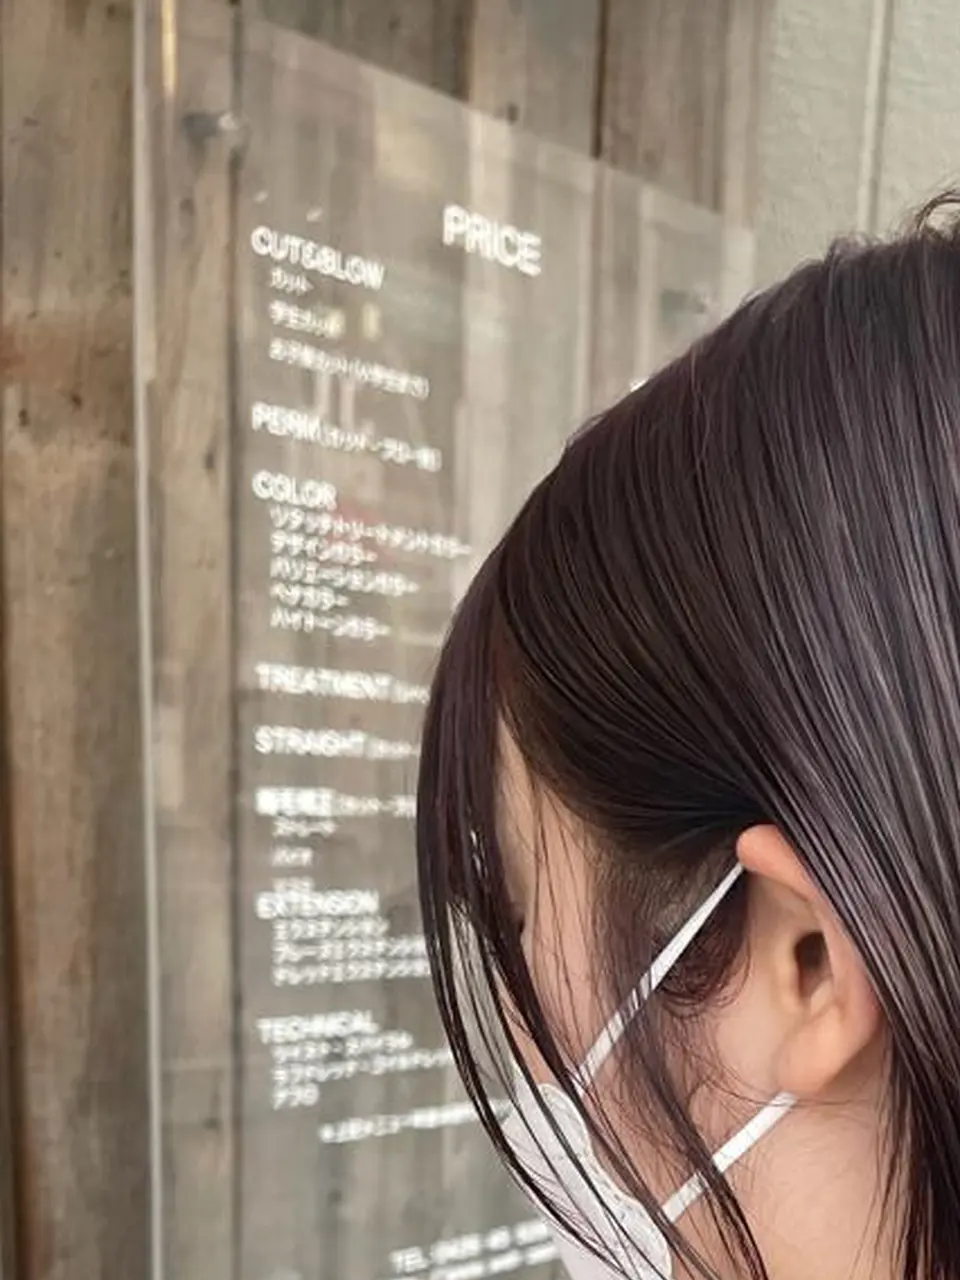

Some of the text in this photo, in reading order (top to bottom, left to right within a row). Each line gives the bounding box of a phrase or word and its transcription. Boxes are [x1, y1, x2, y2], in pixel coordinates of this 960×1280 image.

[442, 204, 542, 276] PRICE
[252, 402, 321, 444] PERM
[252, 469, 337, 511] COLOR
[255, 664, 393, 702] TREATMENT
[255, 725, 365, 758] STRAIGHT
[256, 891, 380, 919] EXTENSION
[256, 1010, 381, 1044] TECHNICAL
